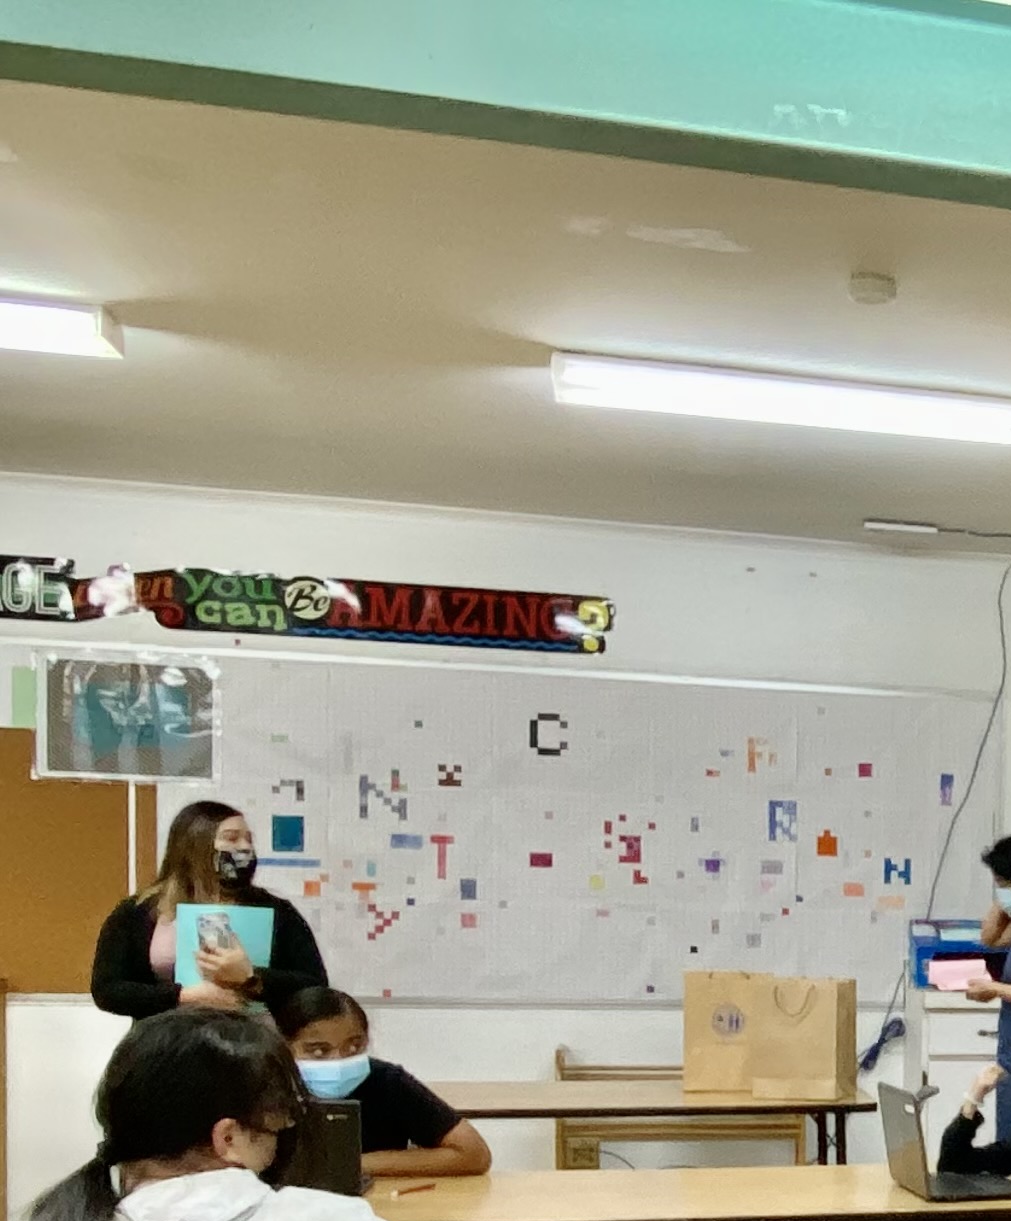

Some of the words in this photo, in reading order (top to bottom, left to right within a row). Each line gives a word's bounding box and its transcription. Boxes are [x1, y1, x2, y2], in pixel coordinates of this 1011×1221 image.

[181, 571, 277, 603] you
[288, 583, 328, 613] Be
[195, 600, 288, 631] can
